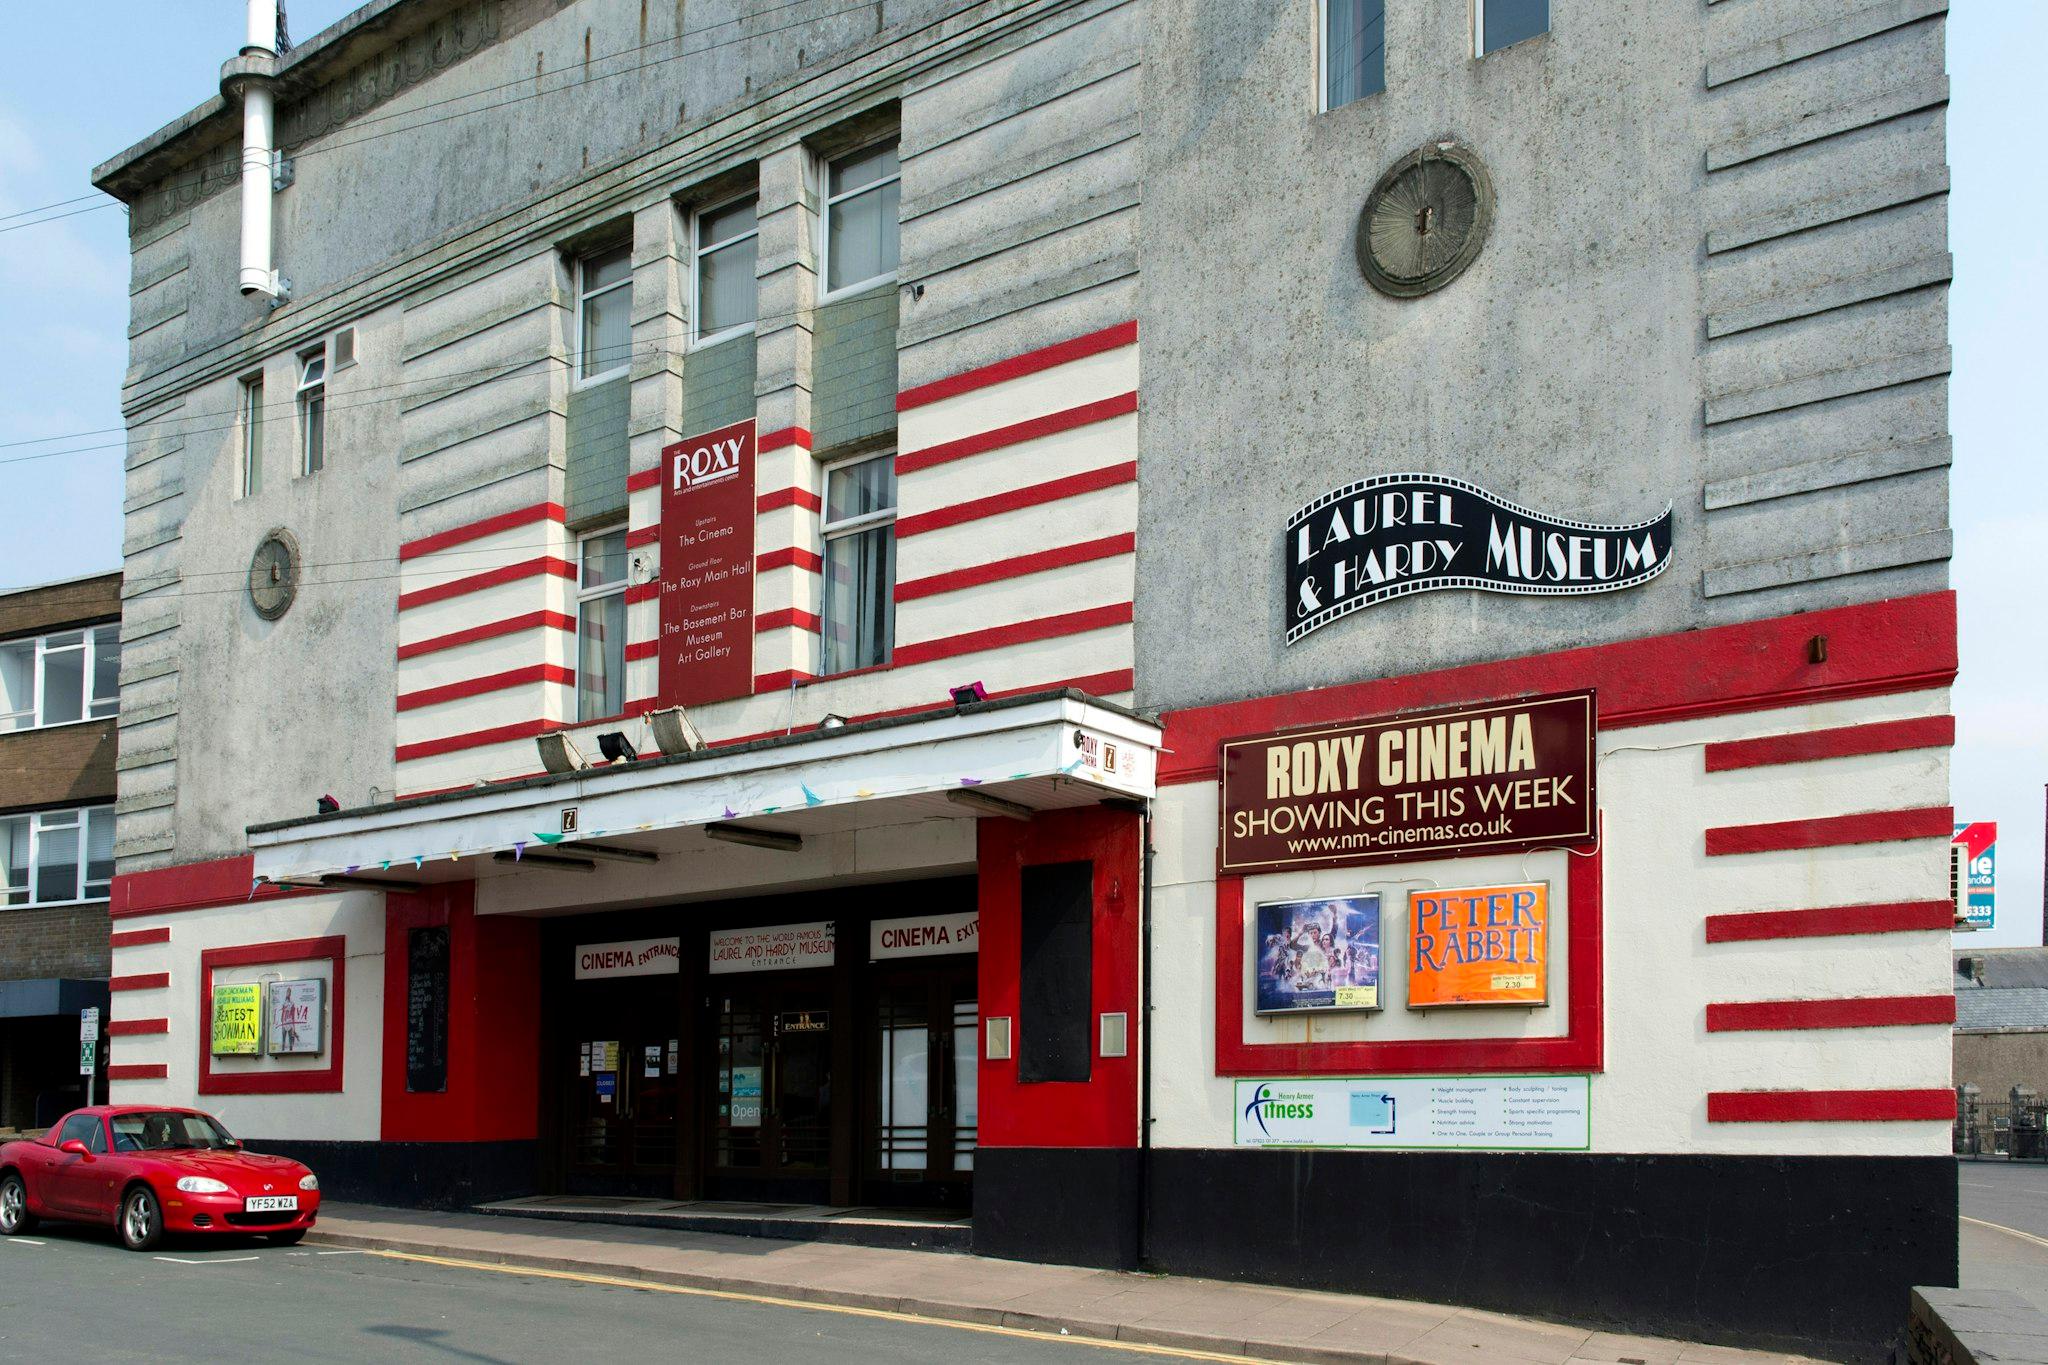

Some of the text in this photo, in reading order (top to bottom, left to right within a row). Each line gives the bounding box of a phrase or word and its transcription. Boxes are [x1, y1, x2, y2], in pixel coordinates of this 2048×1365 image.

[674, 435, 745, 490] ROXY
[695, 516, 717, 527] Upstairs
[1297, 491, 1463, 565] LAUREL
[679, 526, 734, 547] The Cinema
[1486, 513, 1659, 582] MUSEUM
[688, 559, 709, 571] Ground
[661, 561, 751, 594] The Roxy Main Hall
[1296, 540, 1463, 618] & HARDY
[690, 601, 720, 613] Downstairs
[664, 608, 747, 635] The Basement Bar
[686, 632, 723, 647] Museum
[677, 646, 731, 665] Art Gallery
[1266, 713, 1536, 799] ROXY CINEMA
[1233, 775, 1576, 838] SHOWING THIS WEEK
[1287, 814, 1513, 853] www.nm-cinemas.co.uk
[1416, 891, 1542, 935] PETER
[713, 930, 822, 947] WELCOME TO THE WORLD FAMOUS
[882, 919, 980, 948] CINEMA EXIT
[713, 947, 742, 961] LAUREL
[745, 945, 763, 959] AND
[765, 943, 797, 957] HARDY
[1415, 927, 1541, 973] RABBIT
[581, 951, 634, 970] CINEMA
[752, 956, 797, 967] ENTRANCE
[1505, 981, 1521, 989] 2.30
[785, 1021, 826, 1031] ENTRANCE
[1278, 1092, 1295, 1102] Henry
[732, 1105, 760, 1120] Open
[251, 1197, 294, 1209] YF52 WZA
